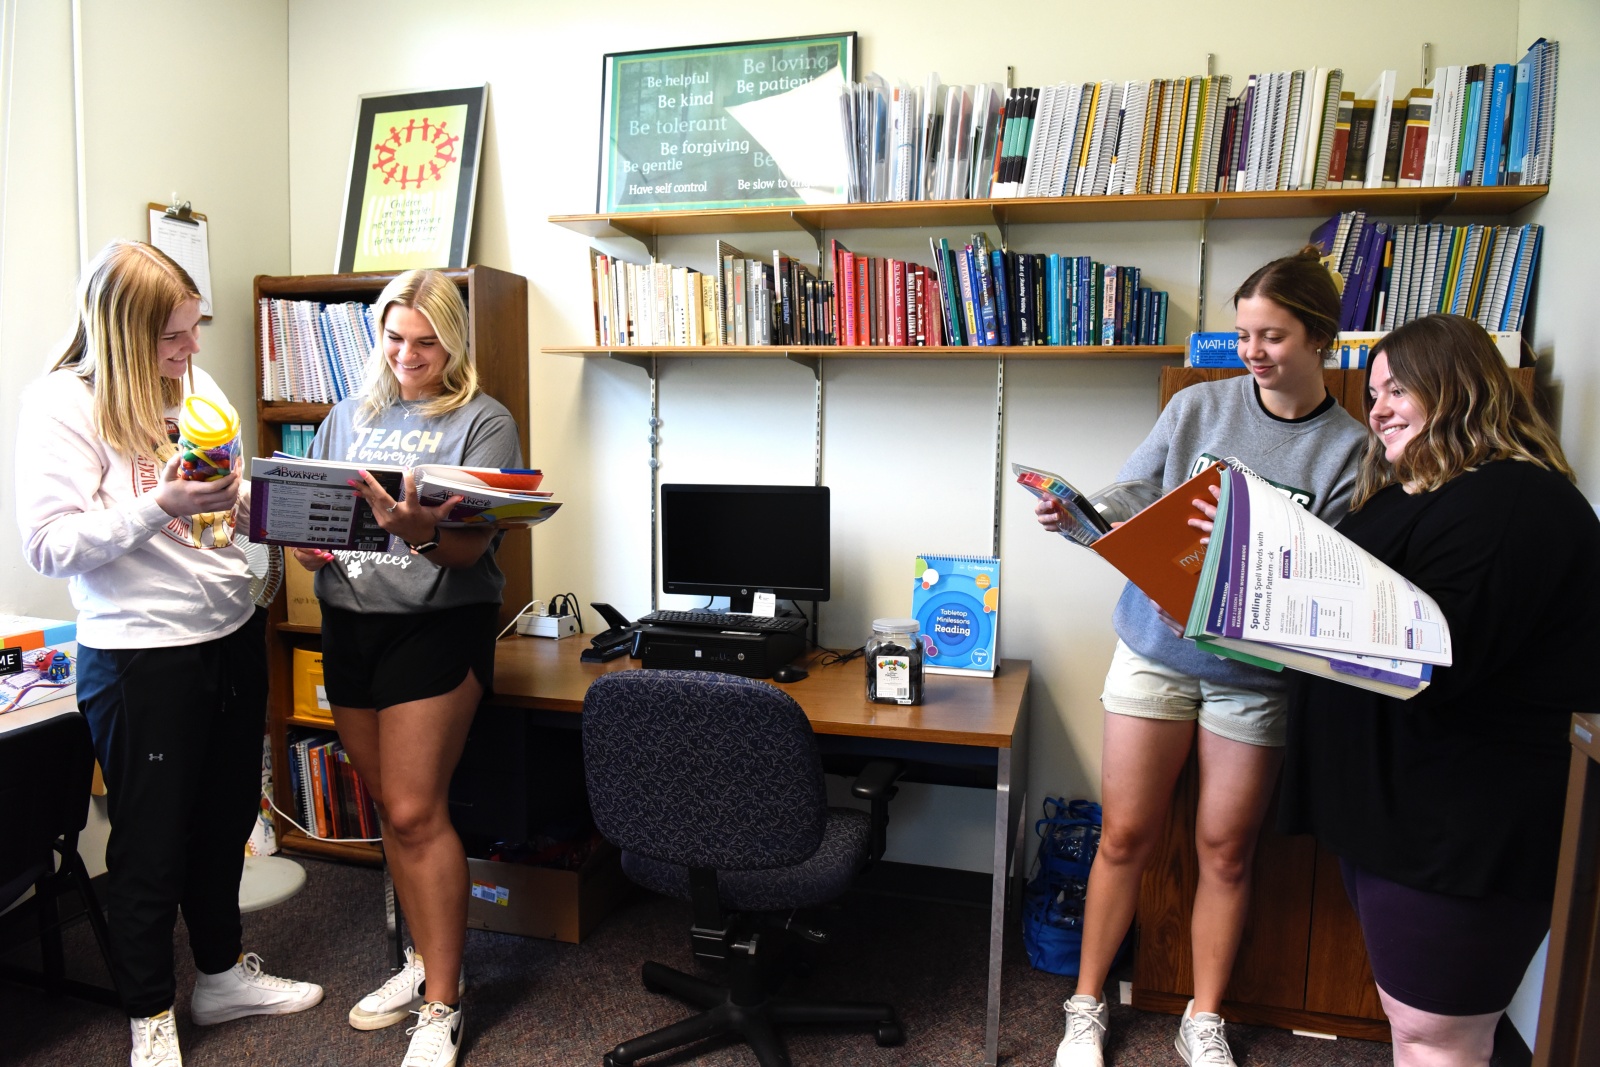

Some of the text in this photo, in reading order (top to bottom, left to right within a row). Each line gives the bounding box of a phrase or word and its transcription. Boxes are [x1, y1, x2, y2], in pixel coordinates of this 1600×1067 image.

[744, 54, 828, 74] Be loving
[647, 72, 709, 88] Be helpful
[737, 80, 754, 93] Be
[658, 91, 713, 108] Be kind
[630, 116, 727, 135] Be tolerant
[1357, 121, 1368, 149] PERRINE'S
[660, 139, 749, 156] Be forgiving
[623, 158, 683, 174] Be gentle
[753, 152, 773, 167] Be
[629, 181, 707, 195] Have self control
[737, 179, 750, 189] Be
[753, 179, 775, 190] slow
[778, 179, 788, 189] to
[977, 248, 987, 278] Children's
[960, 253, 971, 298] INVITATIONS
[1198, 340, 1226, 349] MATH
[354, 428, 443, 453] TEACH
[269, 470, 328, 481] ADVANCE
[282, 466, 327, 477] Benchmark
[1250, 531, 1264, 629] Spelling Spell Words with
[1262, 551, 1275, 631] Consonant Pattern -ck
[1216, 581, 1229, 627] WRITING WORKSHOP
[936, 616, 970, 625] Minilessons
[940, 609, 967, 617] Tabletop
[934, 624, 971, 636] Reading
